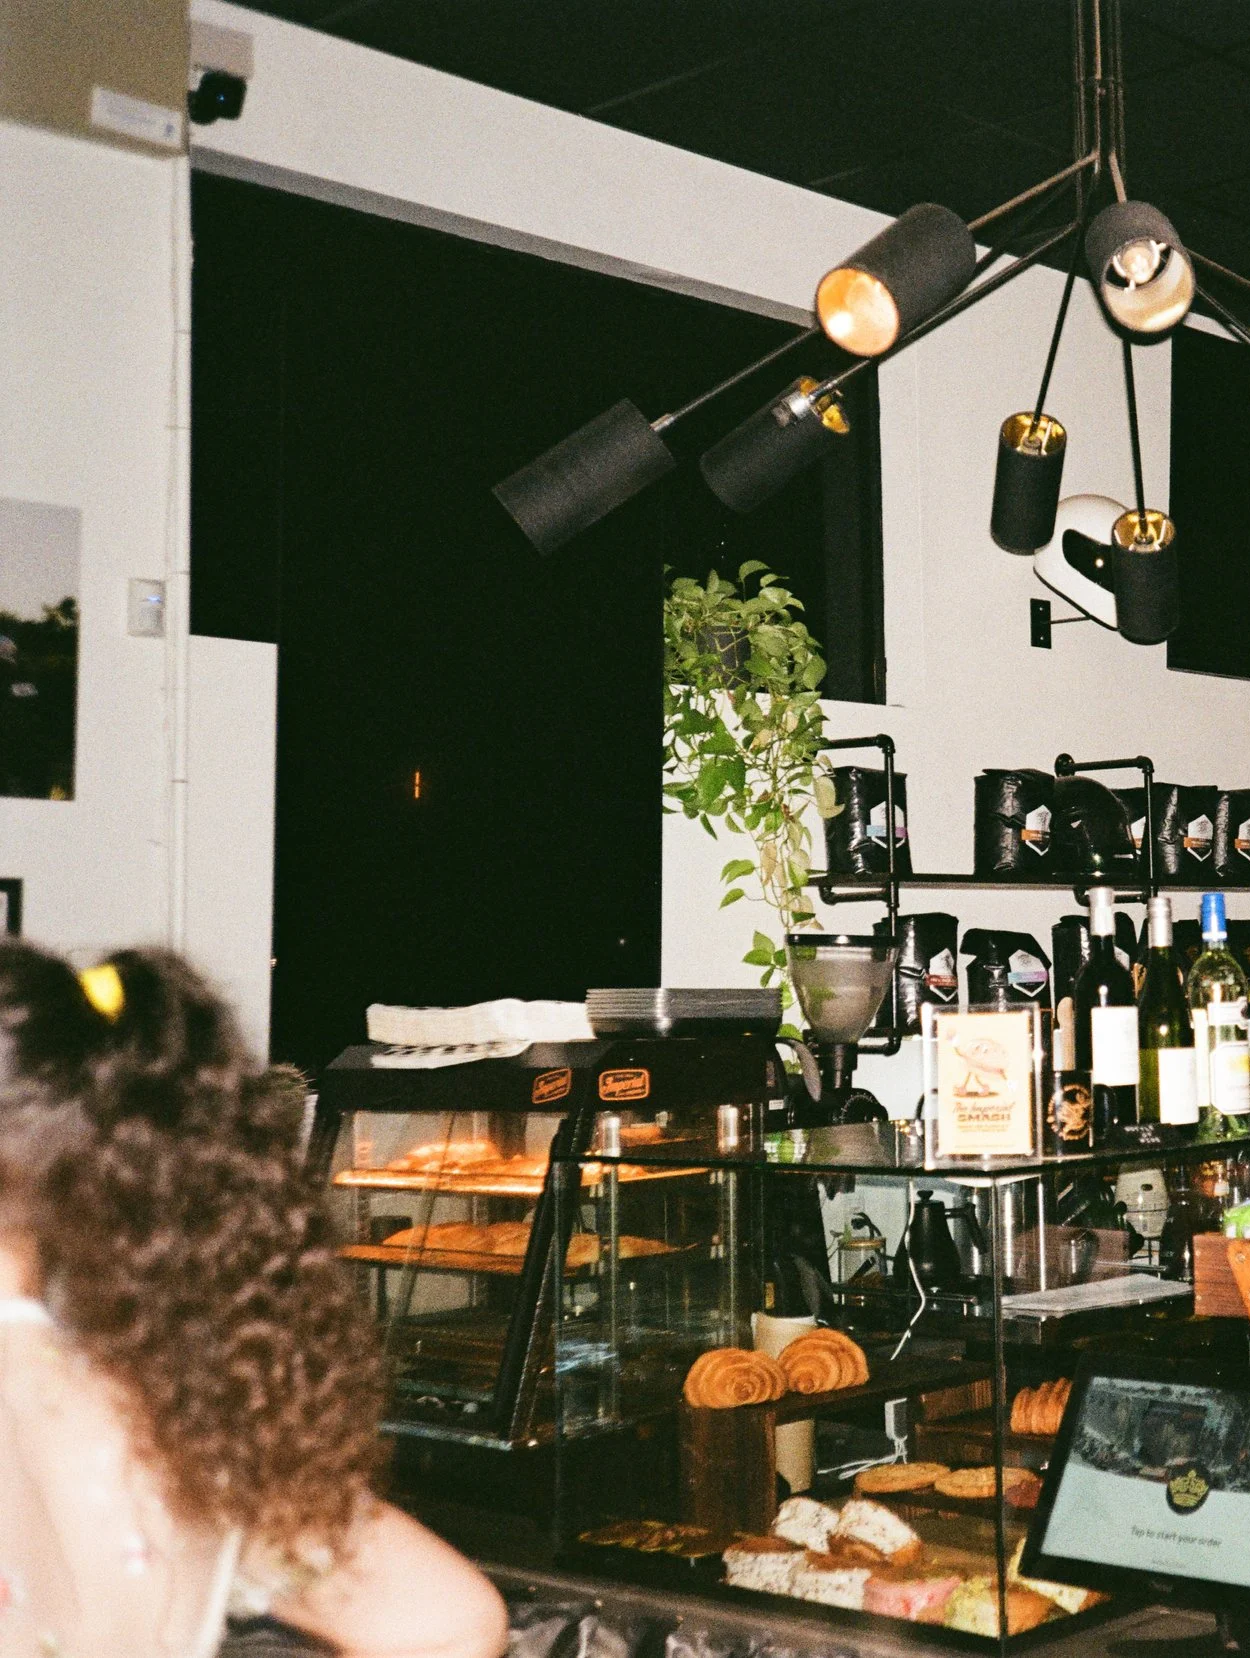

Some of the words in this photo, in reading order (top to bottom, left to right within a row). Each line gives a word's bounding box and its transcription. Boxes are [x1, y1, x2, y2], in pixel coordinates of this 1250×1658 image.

[958, 1113, 1011, 1122] SMASH
[1131, 1525, 1144, 1538] Tap
[1146, 1529, 1155, 1538] to
[1156, 1531, 1177, 1541] start
[1178, 1536, 1197, 1545] your
